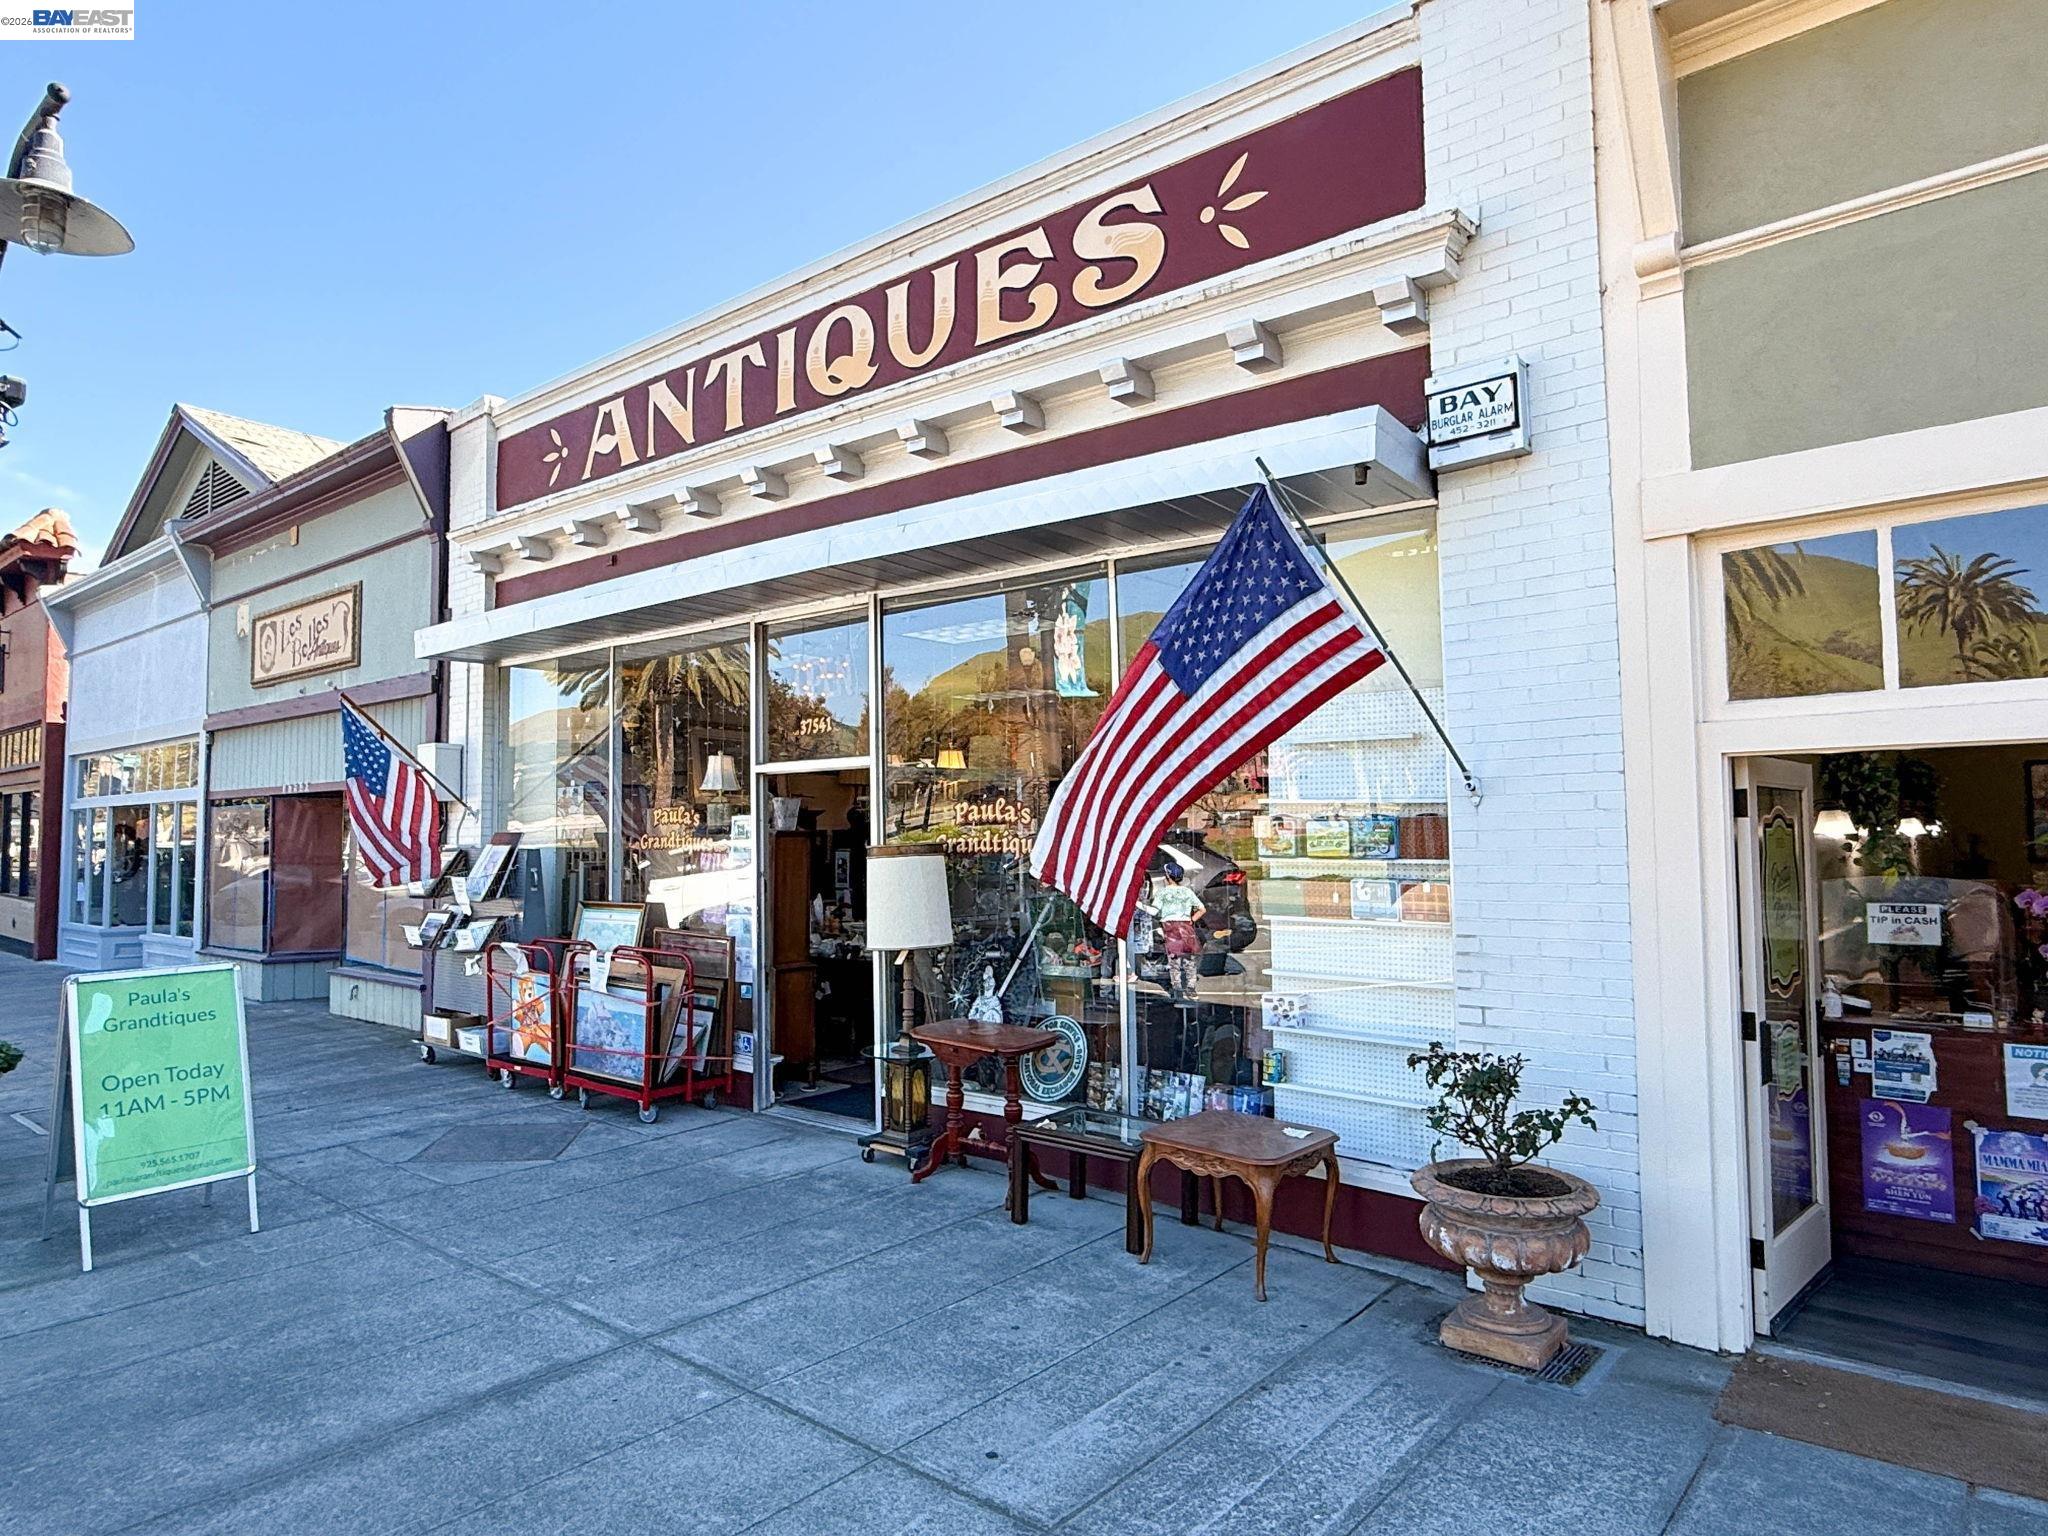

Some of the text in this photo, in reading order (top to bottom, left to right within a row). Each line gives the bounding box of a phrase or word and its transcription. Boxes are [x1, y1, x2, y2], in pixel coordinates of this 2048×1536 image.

[581, 183, 1166, 481] ANTIQUES
[1440, 382, 1502, 415] BAY
[1431, 401, 1514, 431] BURGLAR ALARM
[280, 614, 302, 655] Les
[291, 612, 329, 668] Belles
[800, 716, 832, 736] 37541
[653, 806, 700, 827] Paula's
[954, 798, 1031, 824] Paula's
[640, 831, 713, 854] Grandtiques
[1870, 915, 1888, 924] TIP
[1904, 916, 1938, 926] CASH
[1881, 905, 1925, 914] PLEASE
[127, 987, 191, 1007] Paula's
[103, 1007, 217, 1033] Grandtiques
[101, 1062, 225, 1094] Open Today
[99, 1092, 165, 1119] 11AM
[184, 1085, 230, 1108] 5PM
[1982, 1153, 2025, 1171] MAMMA
[1885, 1188, 1910, 1198] SHEN
[1912, 1190, 1932, 1201] YUN
